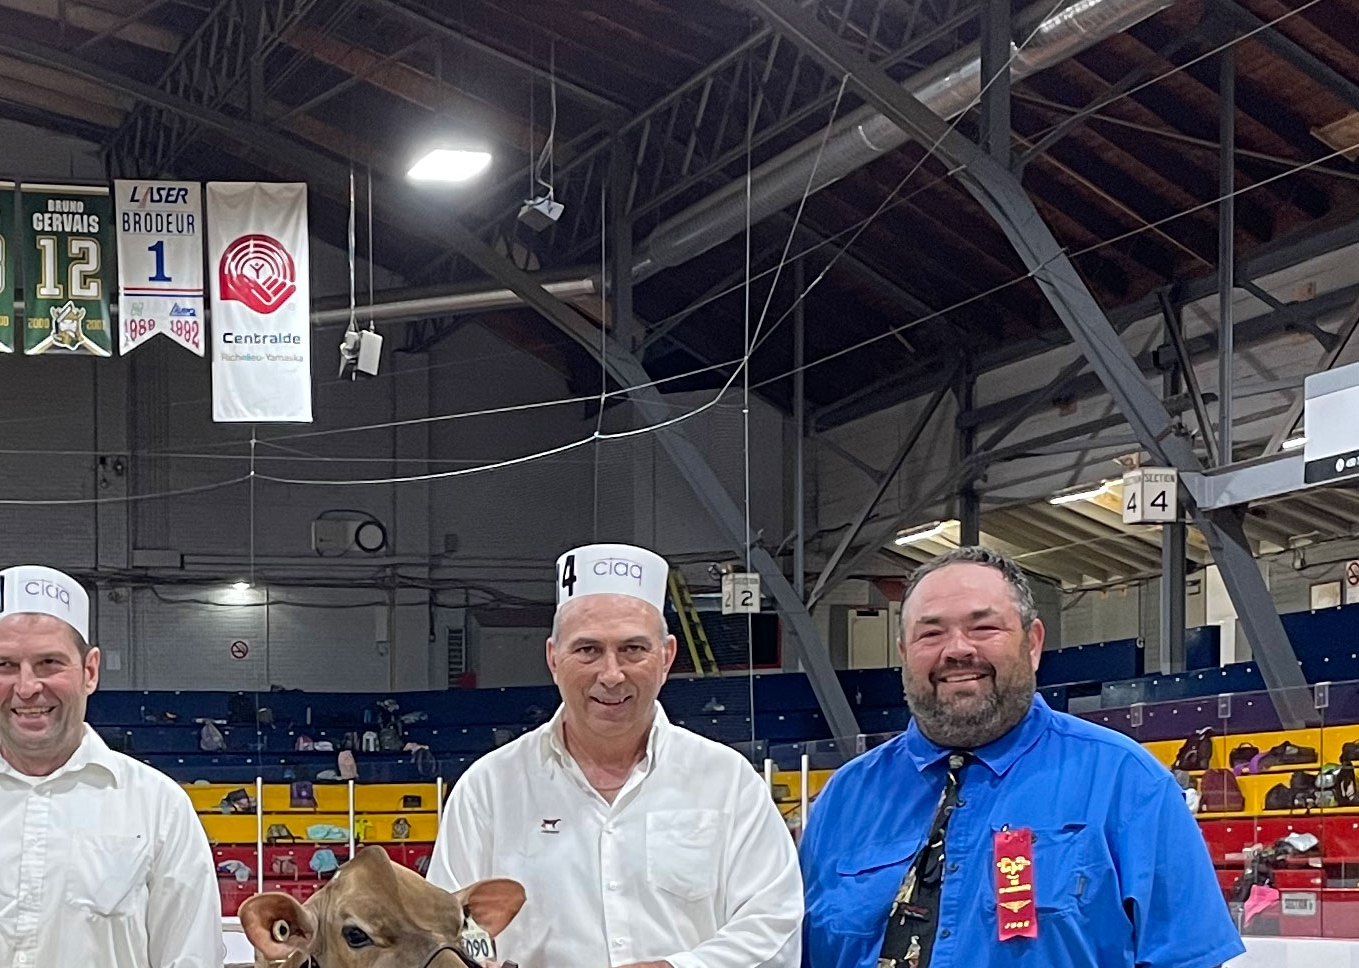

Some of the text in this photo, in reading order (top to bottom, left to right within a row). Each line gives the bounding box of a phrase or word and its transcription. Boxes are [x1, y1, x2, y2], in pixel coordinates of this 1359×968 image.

[47, 200, 84, 213] BRUNO
[130, 186, 189, 207] LASER
[32, 212, 100, 233] GERVAIS
[122, 212, 195, 234] BRODEUR
[36, 235, 102, 300] 12
[148, 240, 172, 282] 1
[1144, 472, 1176, 483] SECTION
[1126, 491, 1137, 514] 4
[1150, 490, 1169, 512] 4
[593, 558, 643, 586] ciaq
[25, 579, 71, 612] ciaq
[741, 590, 754, 607] 2
